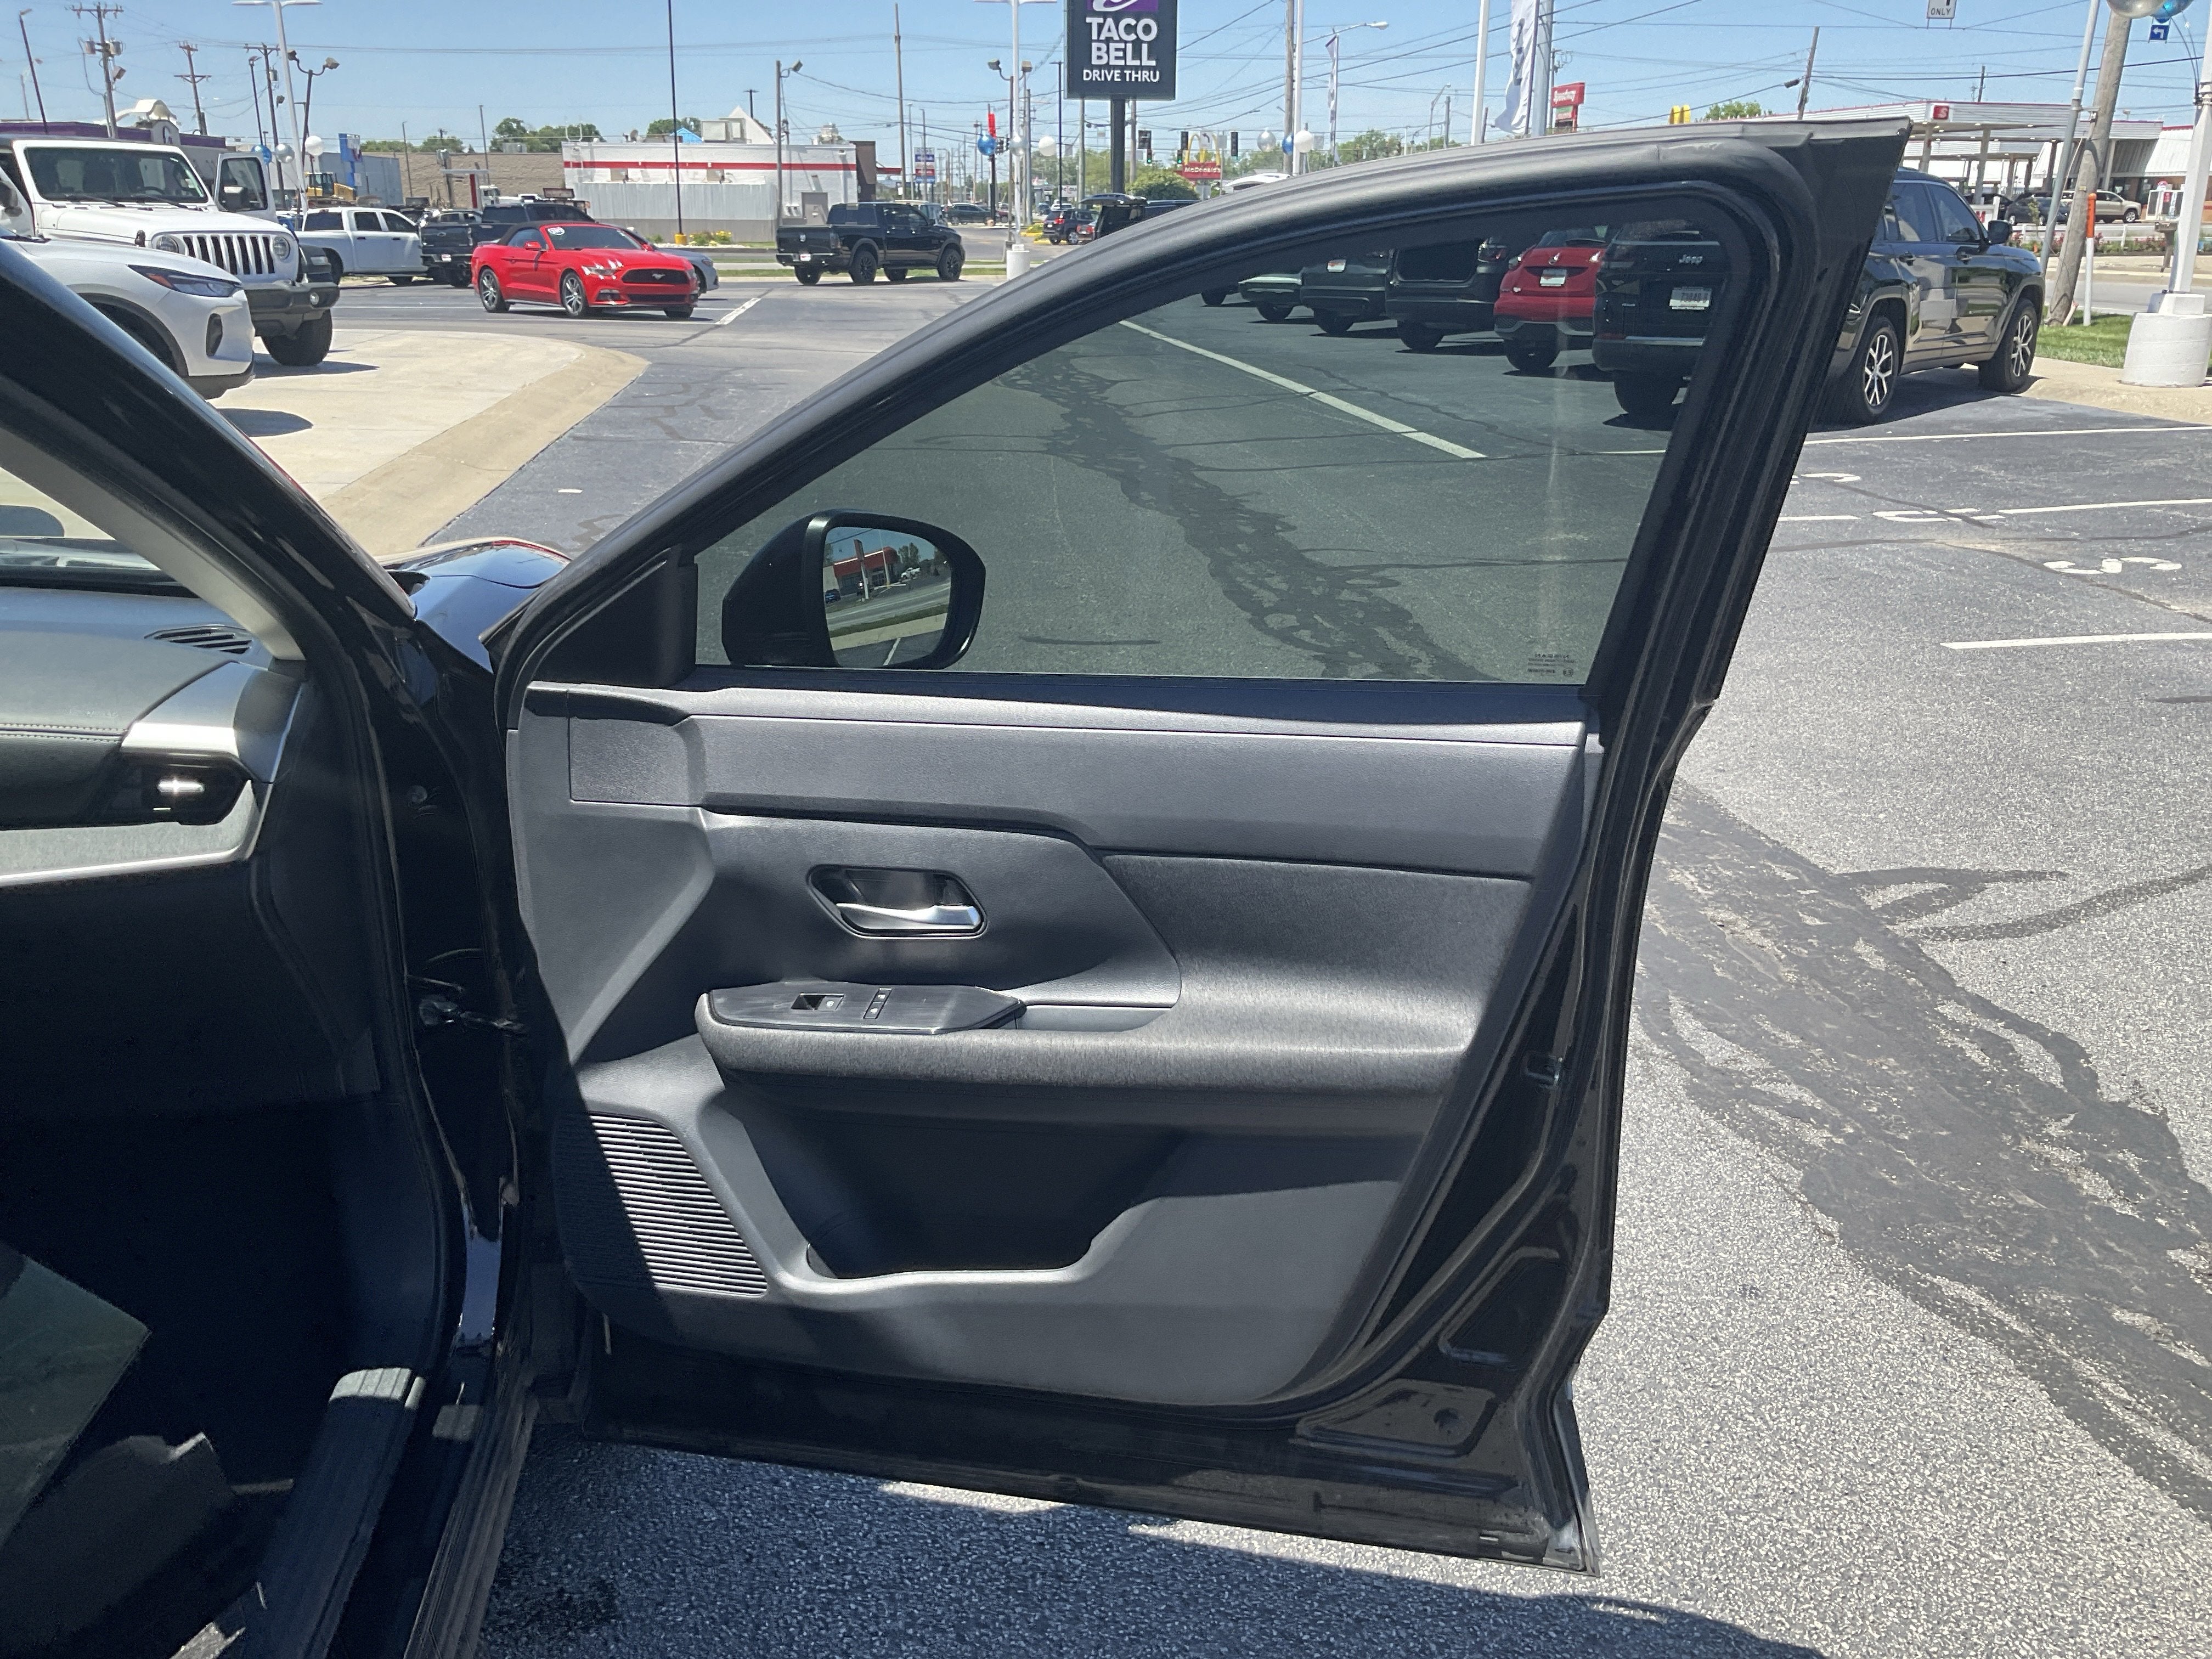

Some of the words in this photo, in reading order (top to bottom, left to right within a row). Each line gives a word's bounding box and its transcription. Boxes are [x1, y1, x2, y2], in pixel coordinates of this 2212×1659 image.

[1085, 17, 1158, 42] TACO
[1091, 42, 1156, 66] BELL
[1082, 69, 1121, 82] DRIVE
[1124, 70, 1160, 82] THRU
[1679, 255, 1703, 265] Jeep
